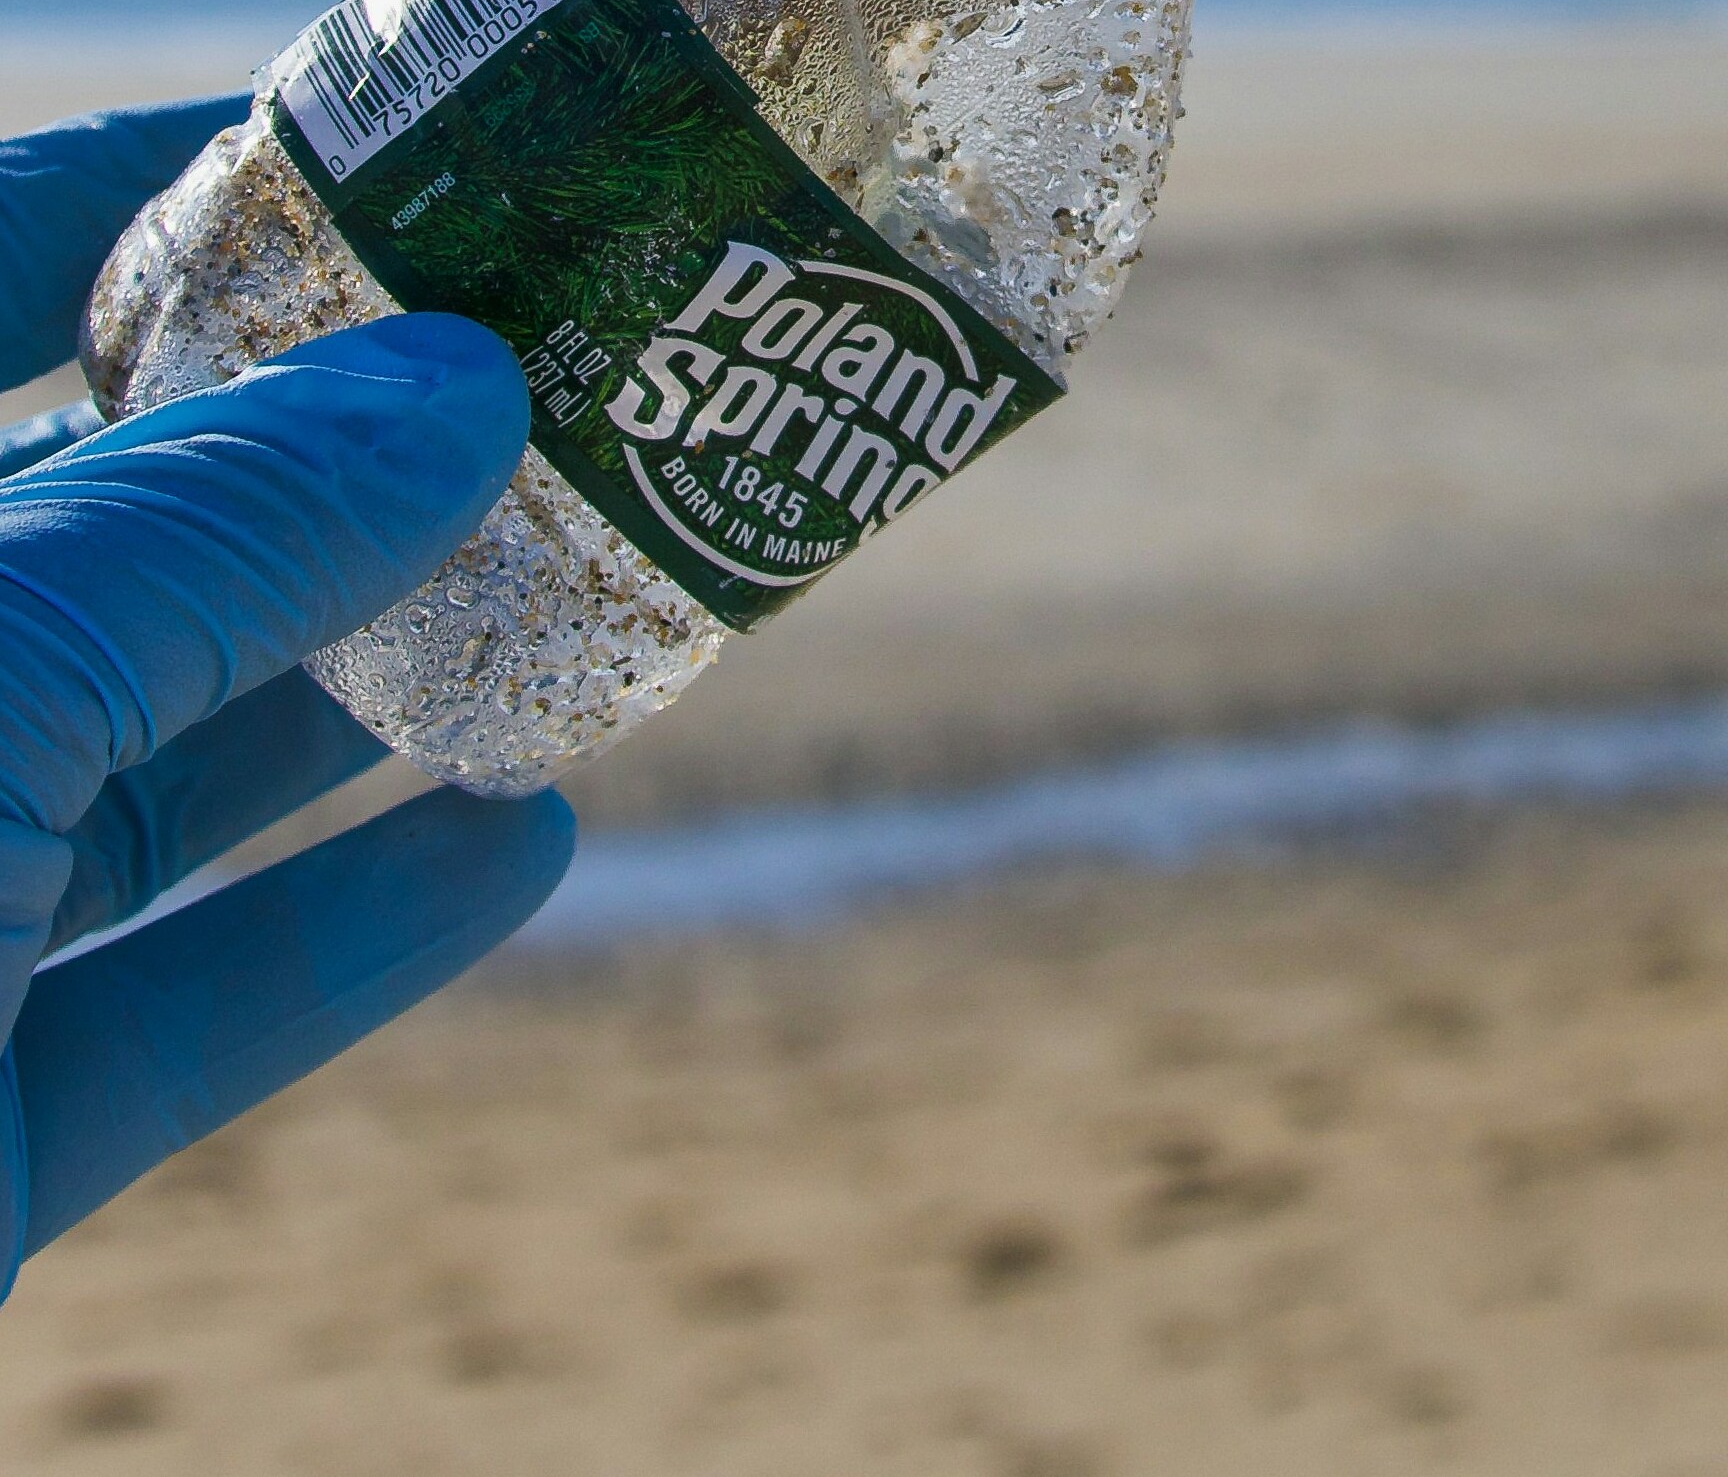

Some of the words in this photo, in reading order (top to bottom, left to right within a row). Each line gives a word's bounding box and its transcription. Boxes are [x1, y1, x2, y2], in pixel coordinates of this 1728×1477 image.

[328, 155, 347, 176] 0
[372, 56, 461, 137] 75720
[390, 172, 456, 231] 43987188
[545, 319, 575, 345] 8
[556, 331, 589, 364] FL
[663, 240, 1018, 474] Poland
[573, 347, 612, 386] OZ
[543, 386, 592, 429] mL)
[660, 455, 724, 528] BORN
[724, 517, 758, 551] IN
[762, 533, 847, 564] MAINE
[718, 455, 809, 529] 1845
